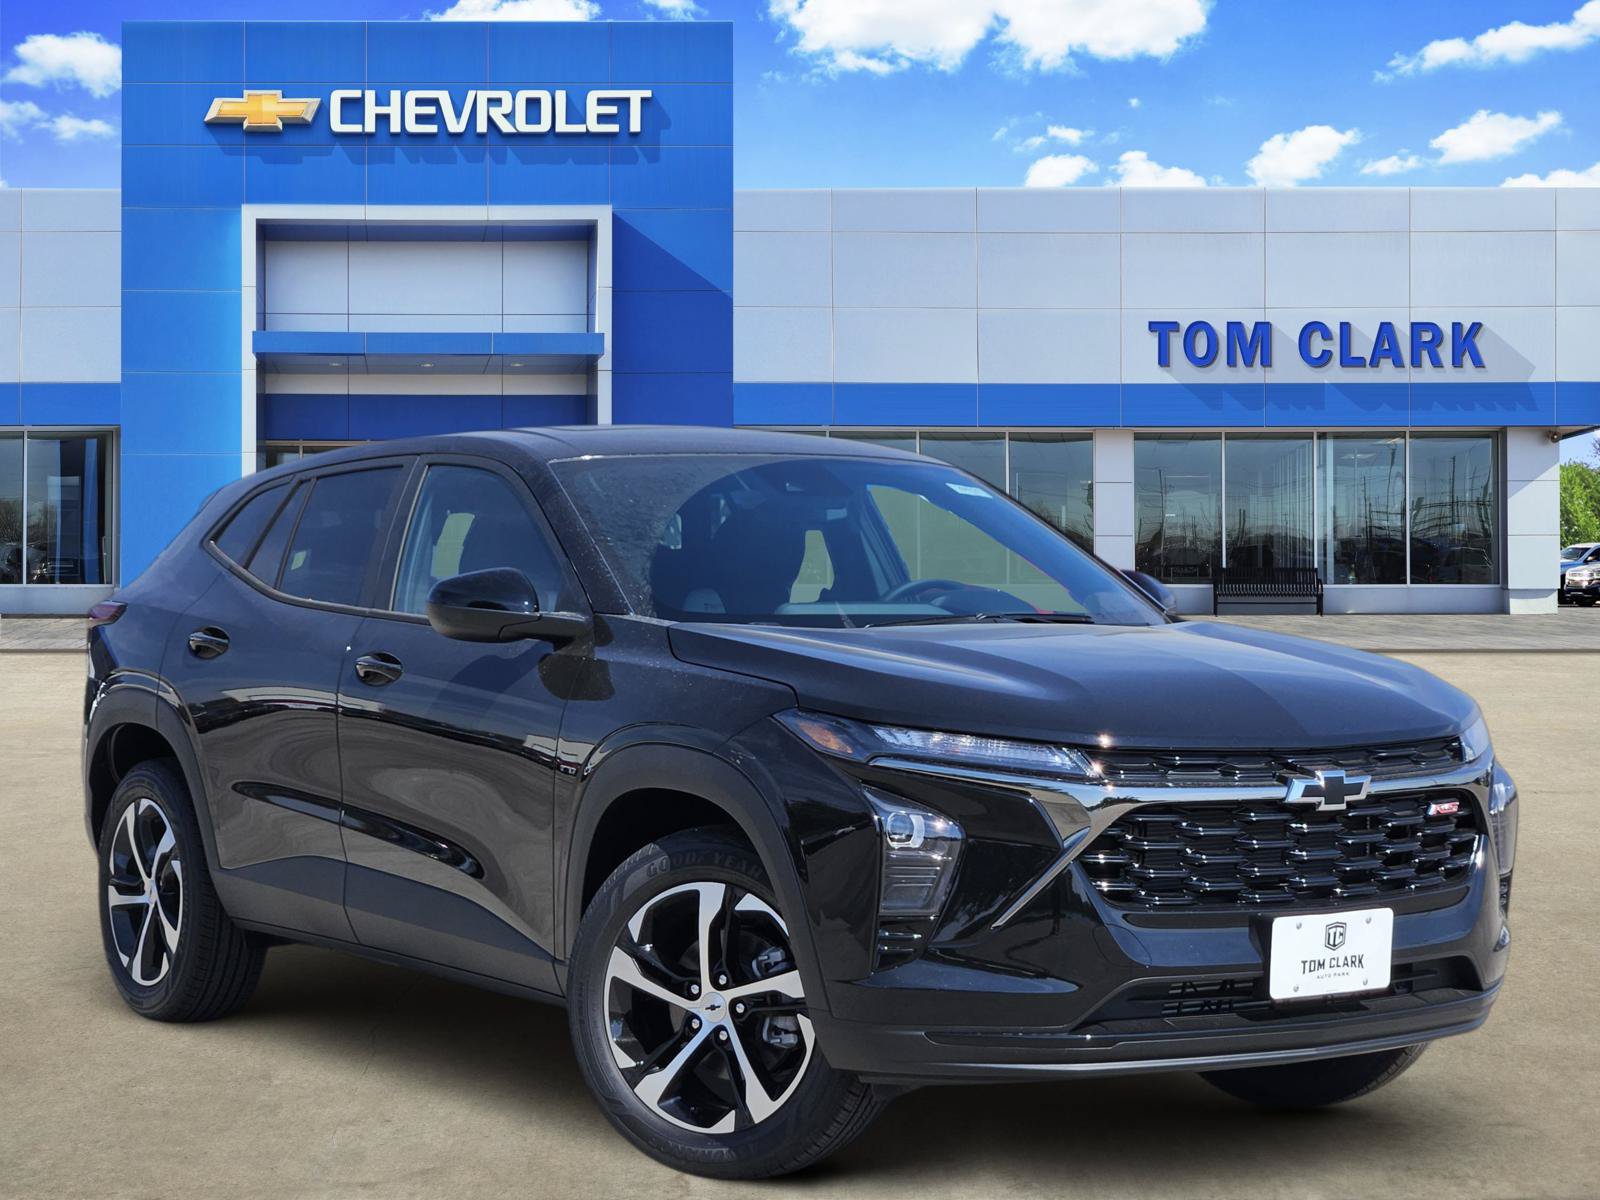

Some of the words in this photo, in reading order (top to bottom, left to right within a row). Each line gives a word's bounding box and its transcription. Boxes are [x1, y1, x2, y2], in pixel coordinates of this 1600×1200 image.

[329, 89, 653, 135] CHEVROLET
[1147, 320, 1273, 369] TOM
[1298, 320, 1487, 369] CLARK
[1301, 958, 1326, 975] TOM
[1329, 954, 1365, 969] CLARK
